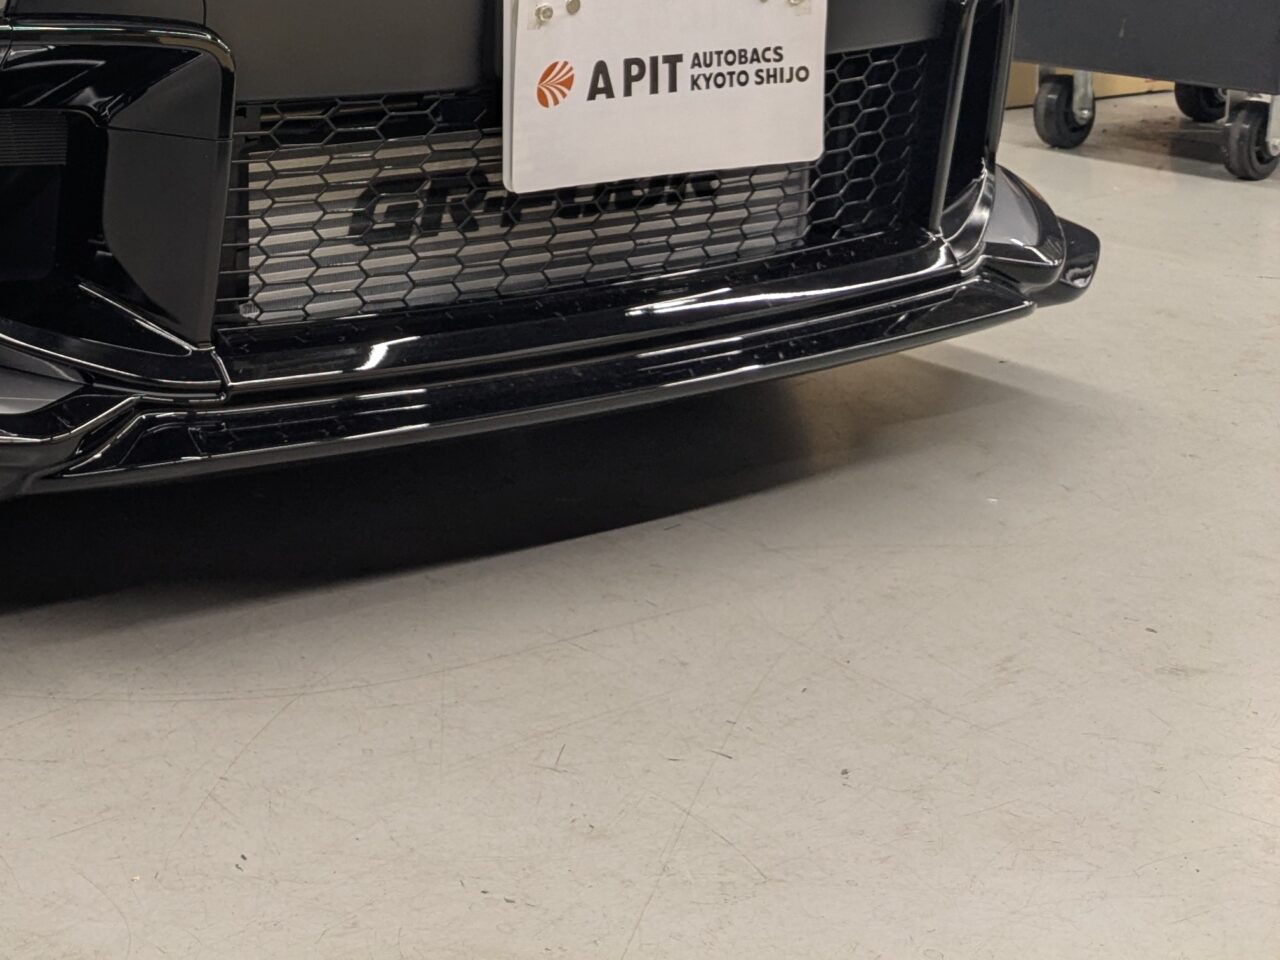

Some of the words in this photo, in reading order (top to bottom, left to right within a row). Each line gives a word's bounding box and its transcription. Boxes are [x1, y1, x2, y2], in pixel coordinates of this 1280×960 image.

[690, 45, 784, 70] AUTOBACS
[690, 69, 750, 91] KYOTO
[753, 65, 810, 86] SHIJO
